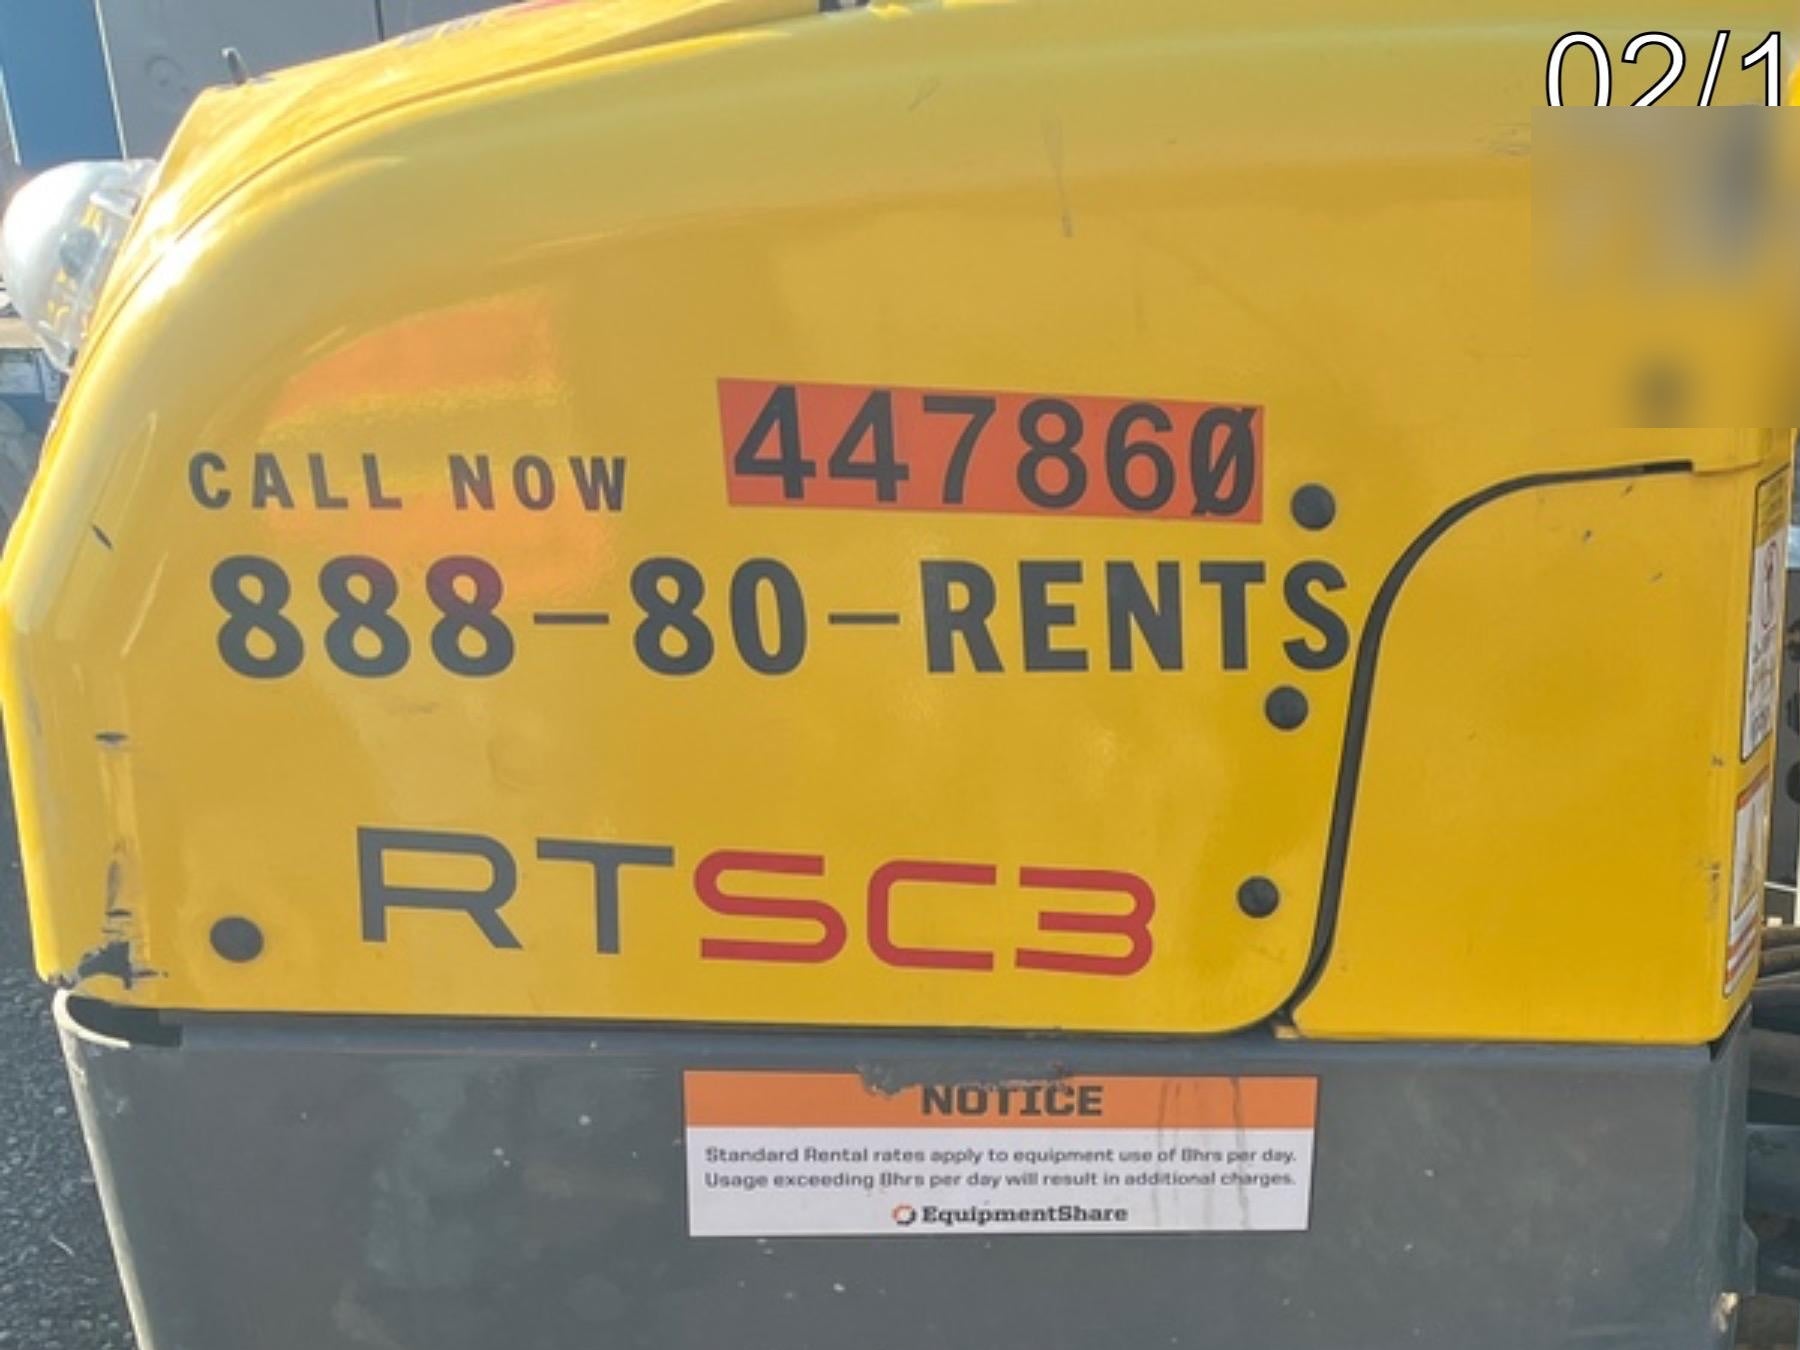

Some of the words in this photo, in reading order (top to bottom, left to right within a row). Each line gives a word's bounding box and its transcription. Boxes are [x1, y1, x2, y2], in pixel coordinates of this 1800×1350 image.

[734, 385, 1257, 517] 447860
[188, 452, 403, 509] CALL
[448, 454, 627, 511] NOW
[210, 554, 1350, 678] 888-80-RENTS
[922, 1085, 1104, 1116] NOTICE
[705, 1147, 799, 1163] Standard
[804, 1147, 868, 1162] Rental
[873, 1149, 925, 1162] rates
[930, 1149, 982, 1165] apply
[988, 1149, 1009, 1162] to
[1013, 1149, 1112, 1164] equipment
[1119, 1151, 1152, 1162] use
[1157, 1149, 1175, 1162] of
[1181, 1149, 1222, 1162] 8hrs
[1227, 1151, 1256, 1164] per
[1262, 1149, 1297, 1163] day.
[705, 1172, 768, 1190] Usage
[773, 1172, 874, 1189] exceeding
[880, 1172, 924, 1186] 8hrs
[930, 1174, 960, 1188] per
[966, 1172, 1001, 1188] day
[1005, 1172, 1039, 1186] will
[1043, 1172, 1098, 1186] result
[1104, 1172, 1120, 1185] in
[1124, 1172, 1216, 1186] additional
[1221, 1172, 1297, 1188] charges.
[922, 1205, 1129, 1226] EquipmentShare
